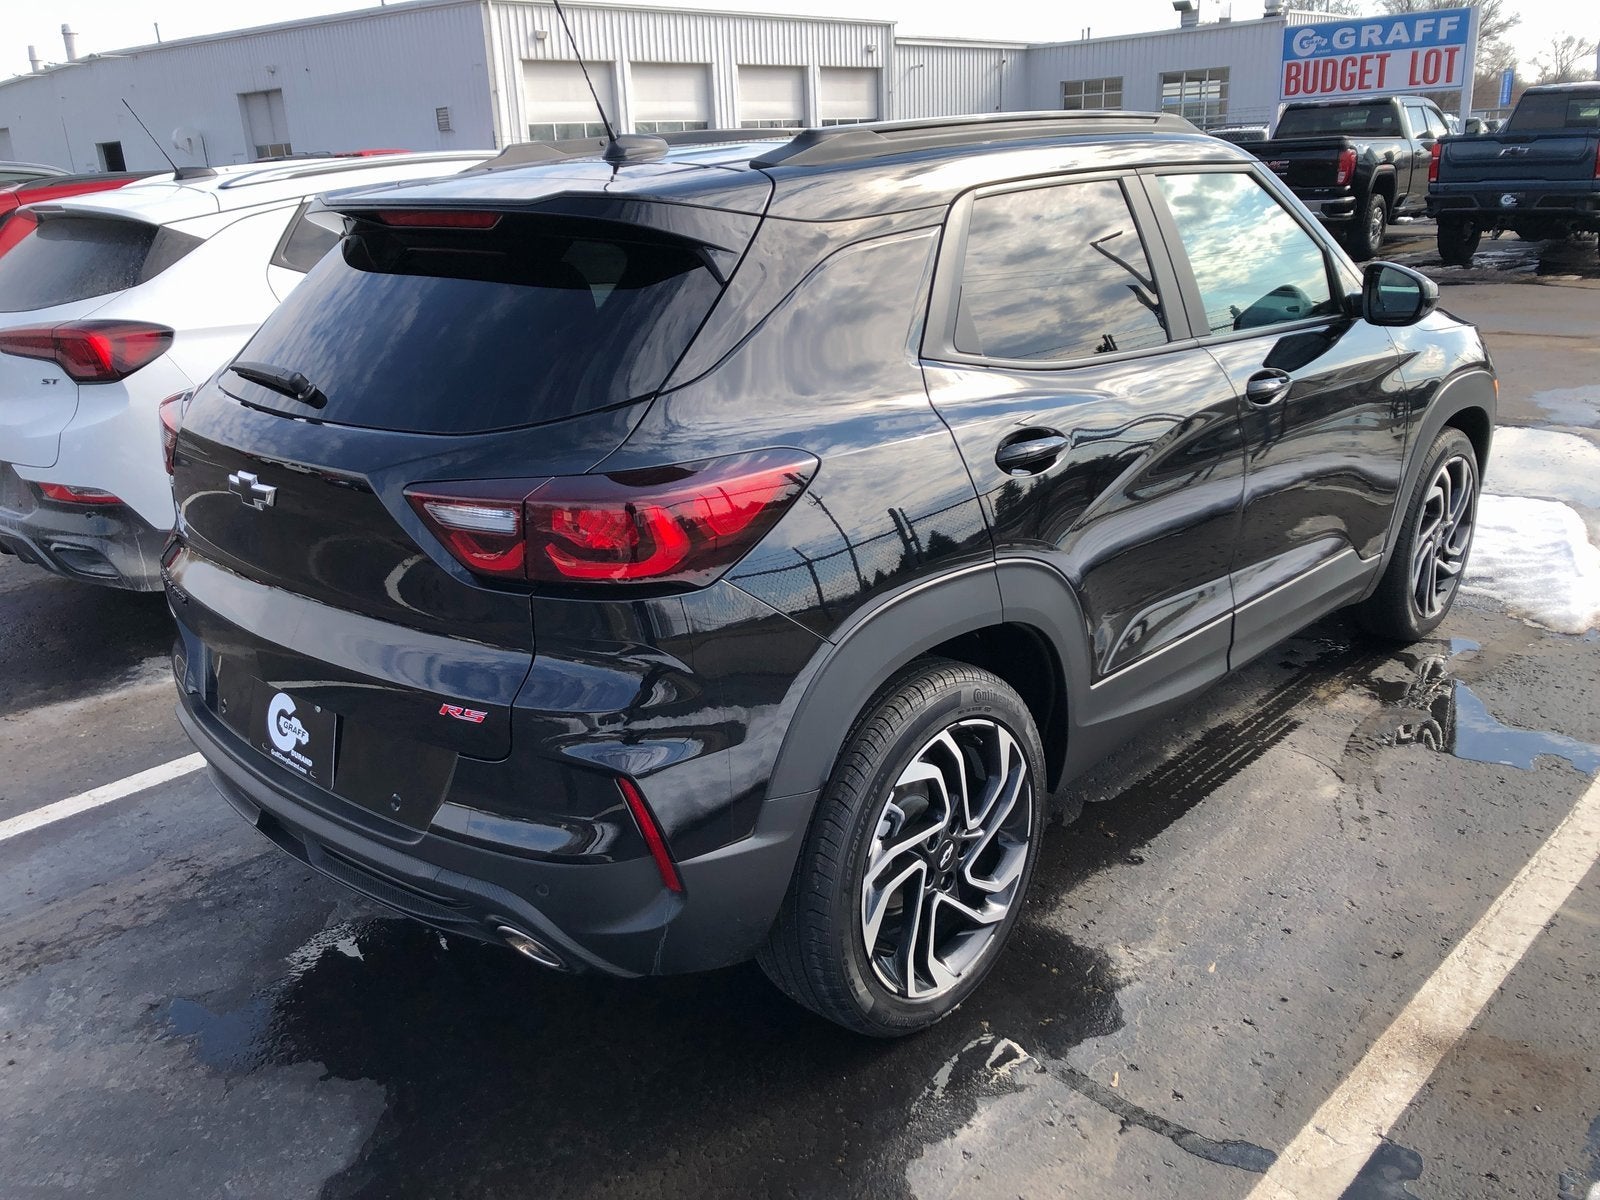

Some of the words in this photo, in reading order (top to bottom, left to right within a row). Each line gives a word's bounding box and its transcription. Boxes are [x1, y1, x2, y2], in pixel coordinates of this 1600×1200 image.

[1332, 16, 1460, 49] GRAFF
[1284, 53, 1391, 96] BUDGET
[1408, 47, 1461, 86] LOT
[438, 703, 488, 723] RS
[283, 720, 307, 739] GRAFF
